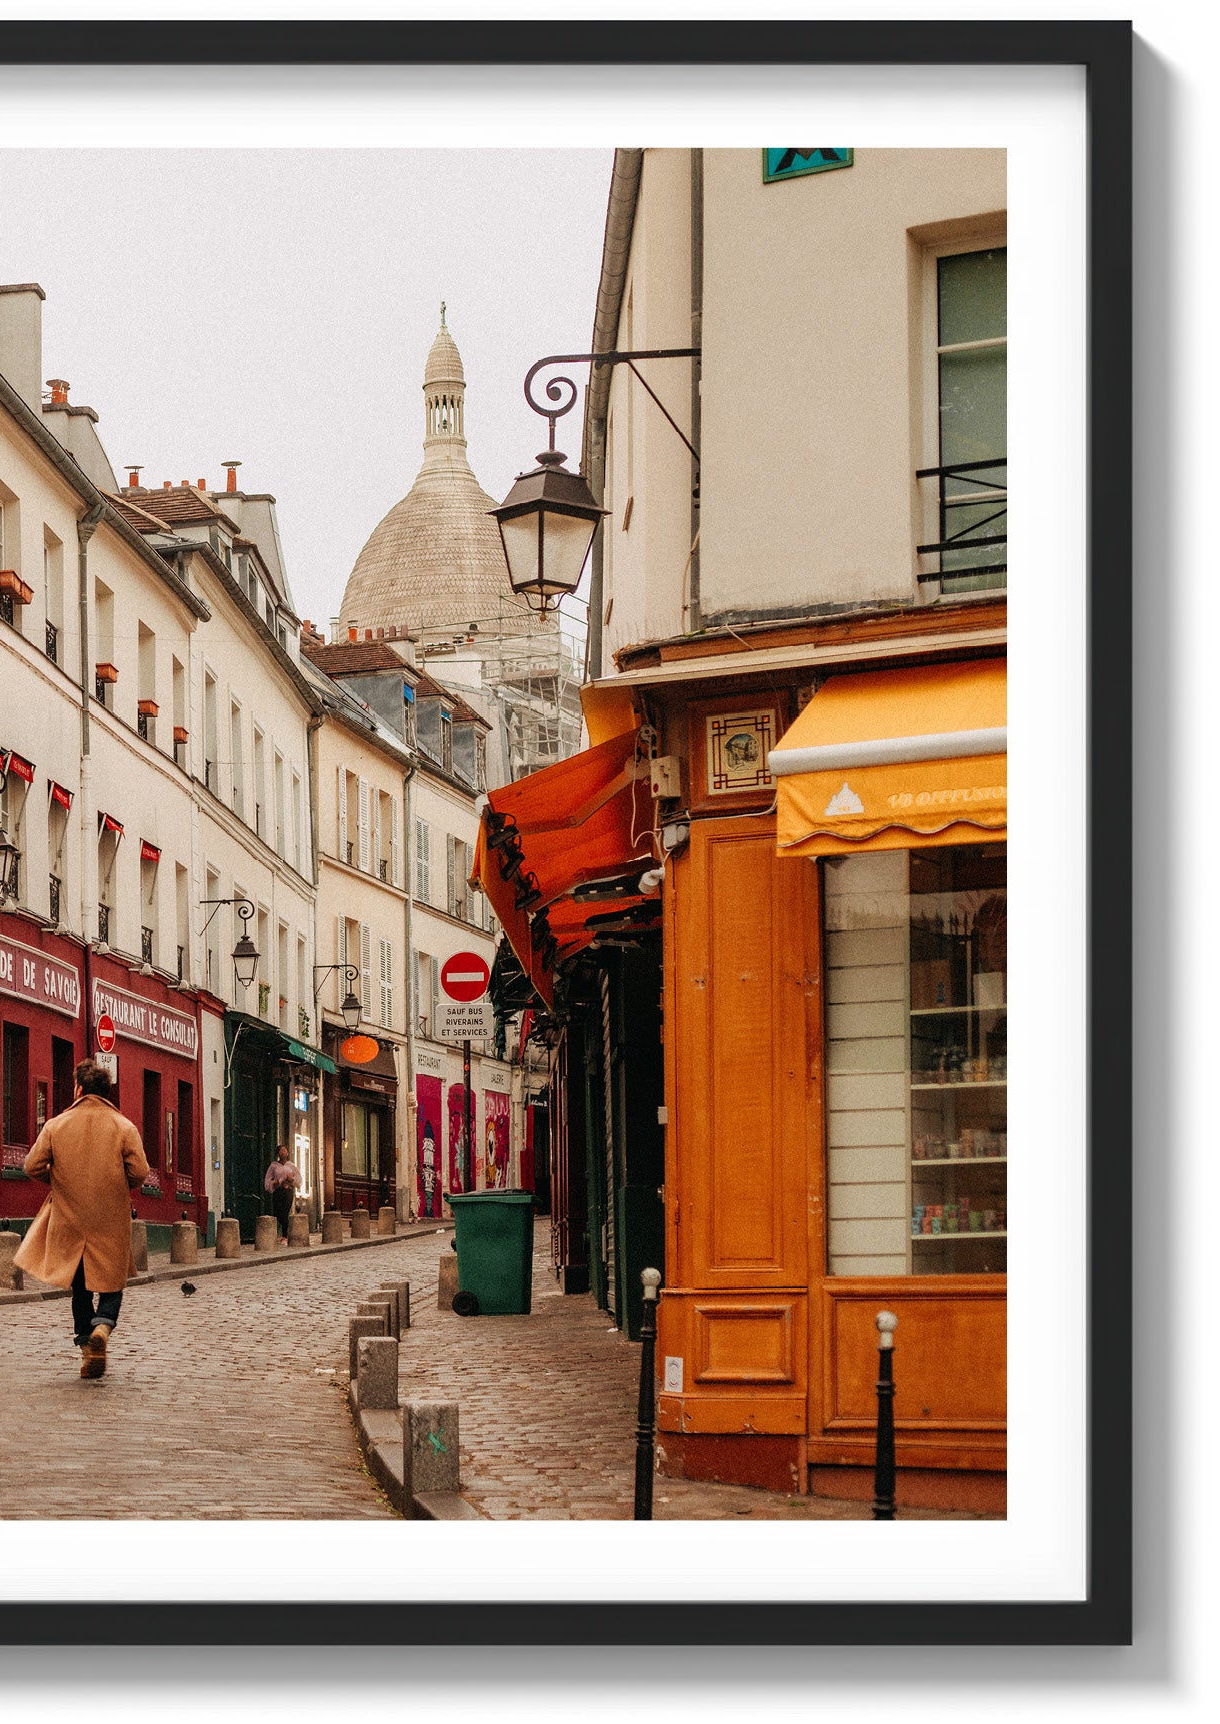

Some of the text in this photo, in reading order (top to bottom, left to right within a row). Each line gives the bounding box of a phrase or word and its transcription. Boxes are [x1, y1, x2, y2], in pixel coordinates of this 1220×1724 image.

[23, 957, 36, 991] DE
[43, 966, 78, 1006] SAVOIE
[94, 993, 196, 1049] RESTAURANT LE CONSULAT
[447, 1007, 483, 1015] SAUF BUS
[418, 1054, 440, 1069] RESTAURANT
